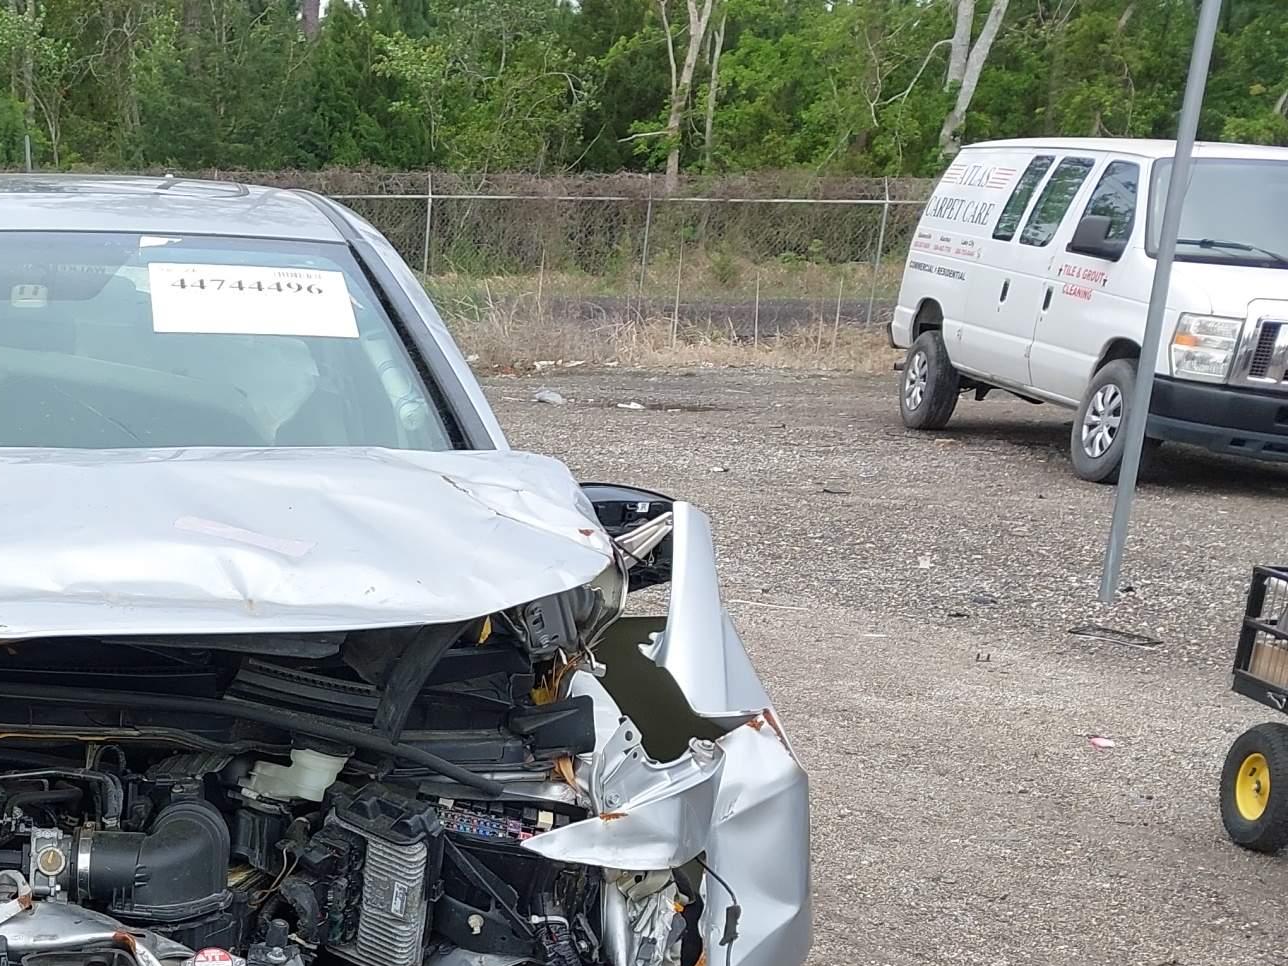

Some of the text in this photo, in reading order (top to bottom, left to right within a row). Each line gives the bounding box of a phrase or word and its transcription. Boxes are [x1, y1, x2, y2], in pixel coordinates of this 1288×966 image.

[926, 195, 995, 226] CARPET CARE
[936, 266, 965, 281] RESIDENTIAL
[1063, 264, 1076, 277] TILE
[1082, 268, 1106, 284] GROUT
[170, 278, 324, 295] 44744496
[1062, 284, 1093, 301] CLEANING
